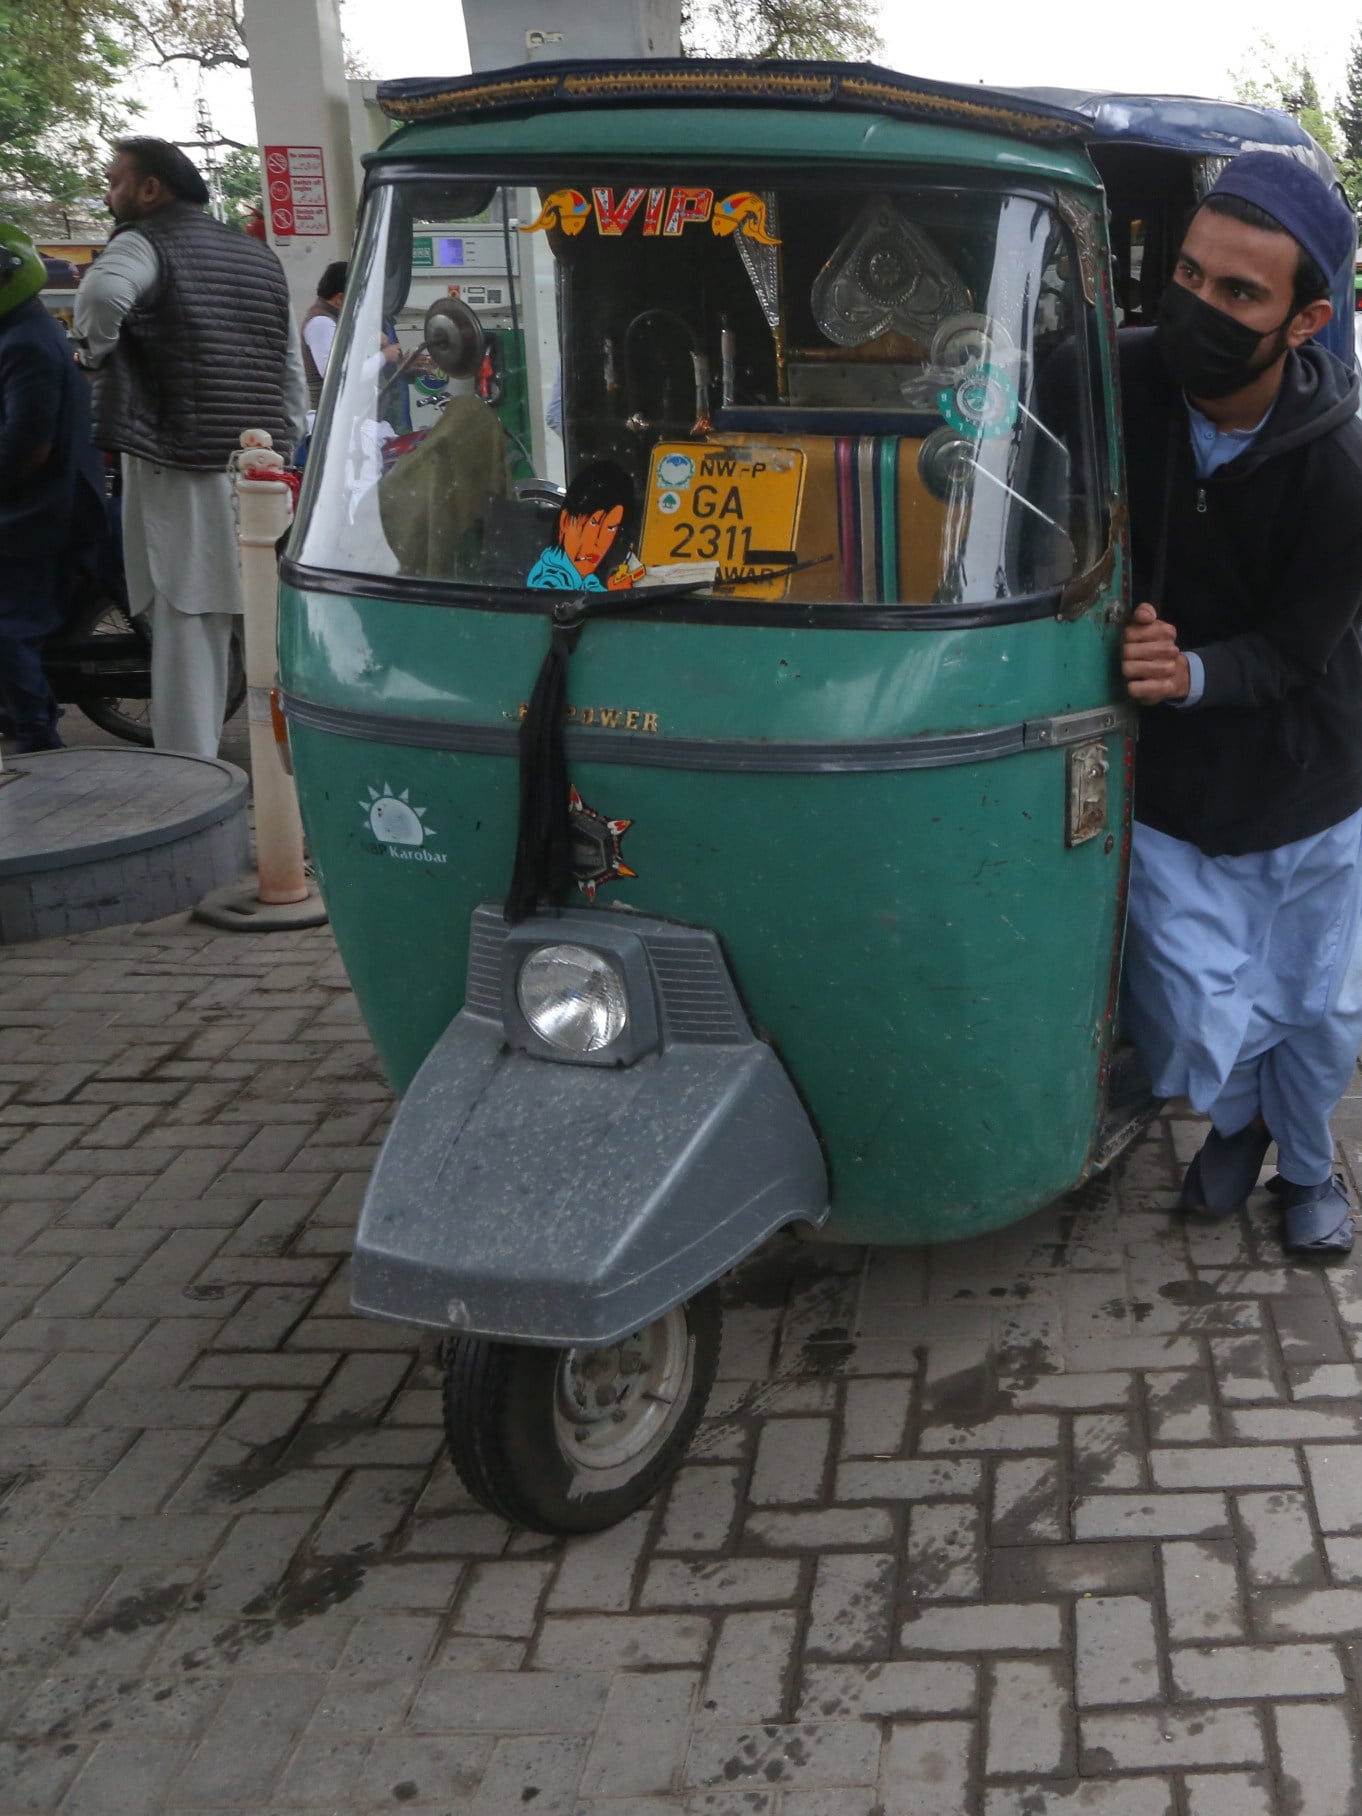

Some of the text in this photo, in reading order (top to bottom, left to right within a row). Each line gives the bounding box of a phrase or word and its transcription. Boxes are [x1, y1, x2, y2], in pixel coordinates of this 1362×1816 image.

[592, 187, 714, 236] VIP
[692, 484, 744, 521] GA
[669, 522, 752, 563] 2311
[388, 845, 449, 863] Karobar
